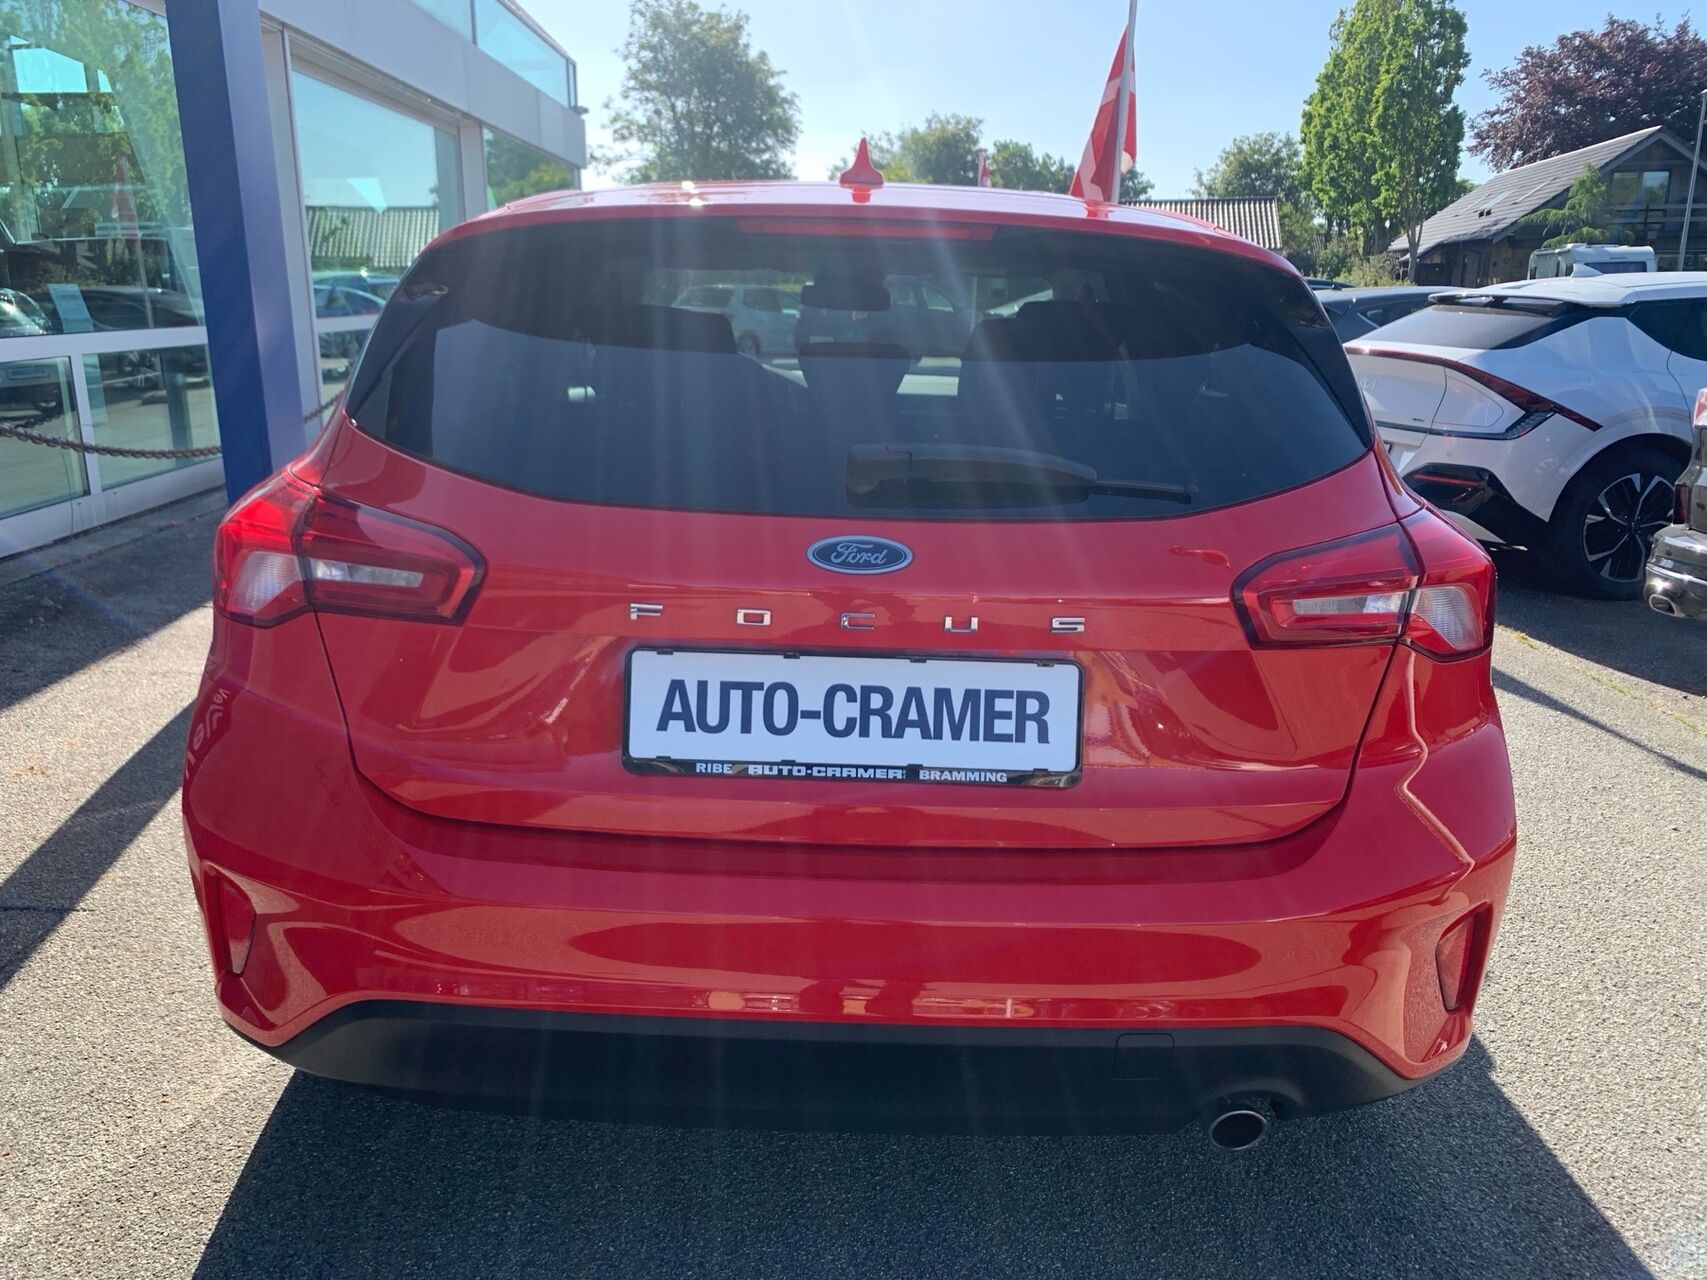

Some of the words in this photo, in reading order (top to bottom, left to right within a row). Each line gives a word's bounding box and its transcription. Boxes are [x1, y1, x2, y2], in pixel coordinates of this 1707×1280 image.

[830, 542, 888, 565] Ford
[630, 602, 1086, 633] FOCUS
[656, 679, 1051, 744] AUTO-CRAMER
[695, 762, 733, 774] RIBE
[919, 769, 1008, 783] BRAMMING
